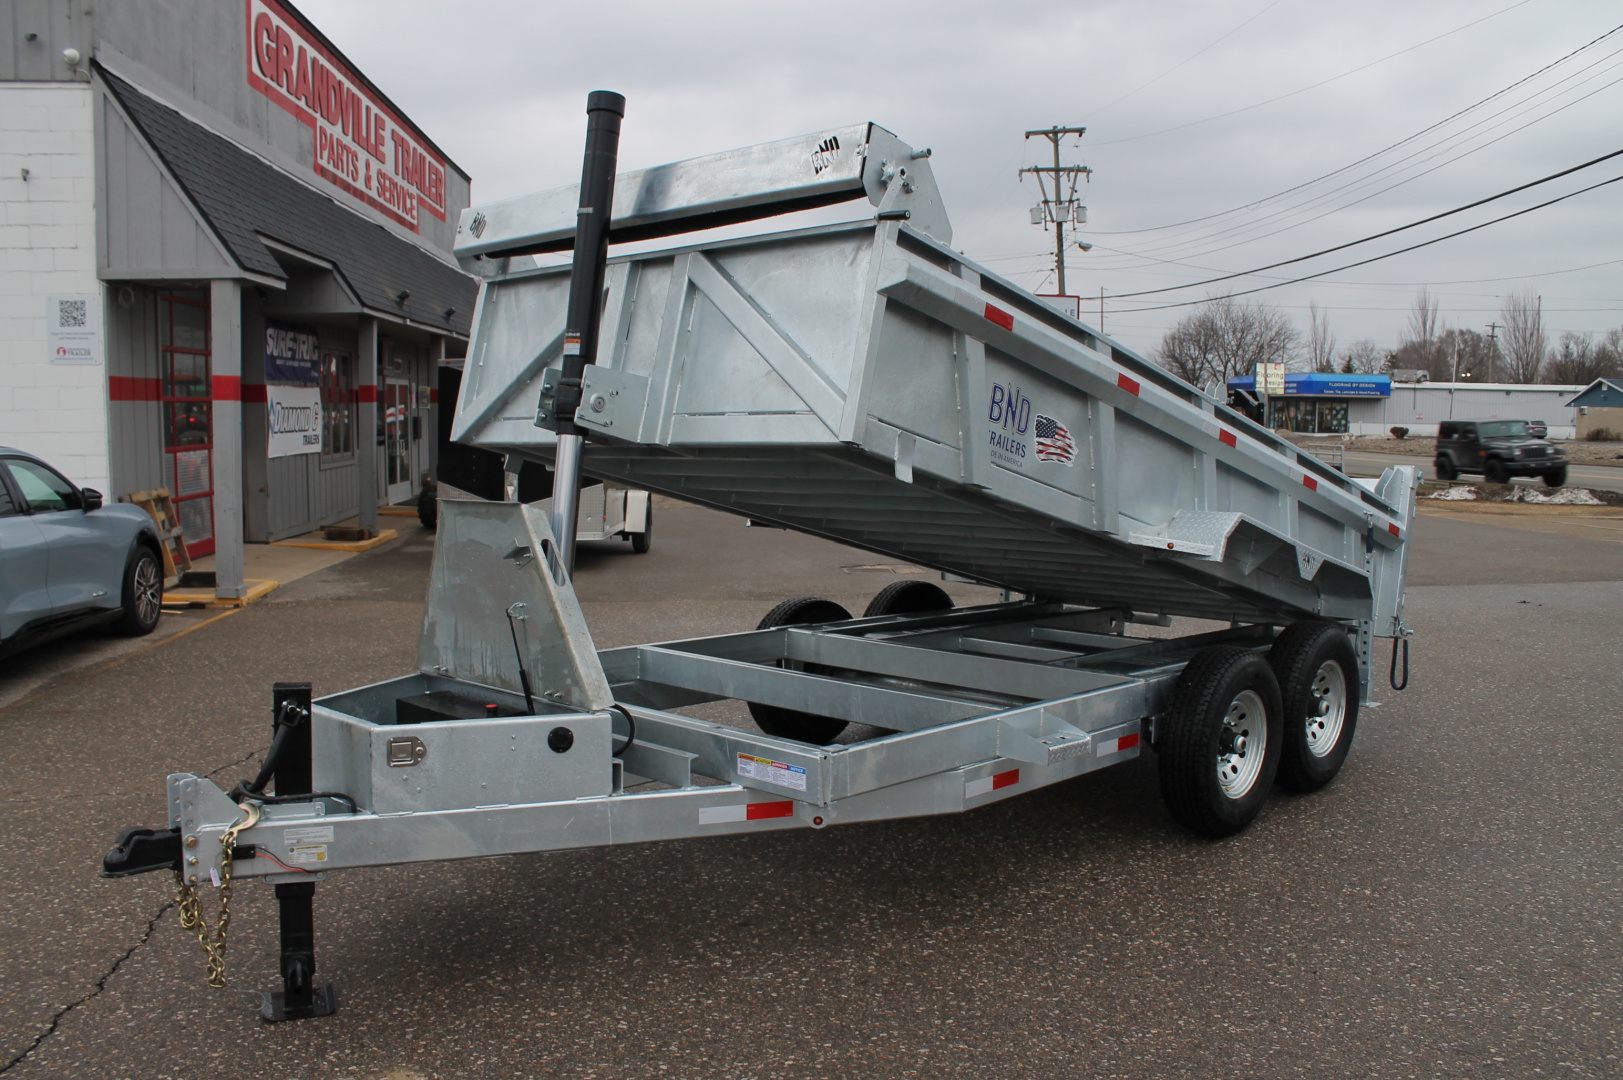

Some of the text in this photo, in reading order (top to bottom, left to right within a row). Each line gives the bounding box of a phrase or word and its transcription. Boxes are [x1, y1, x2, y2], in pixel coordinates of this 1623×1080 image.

[256, 12, 443, 209] GRANDVILLE TRAILER
[319, 125, 416, 220] PARTS & SERVICE
[1256, 371, 1284, 379] Flooring
[988, 382, 1030, 435] BND
[303, 434, 319, 445] TRAILERS
[989, 430, 1026, 458] RAILERS
[998, 453, 1003, 461] IN
[1003, 455, 1023, 468] AMERICA
